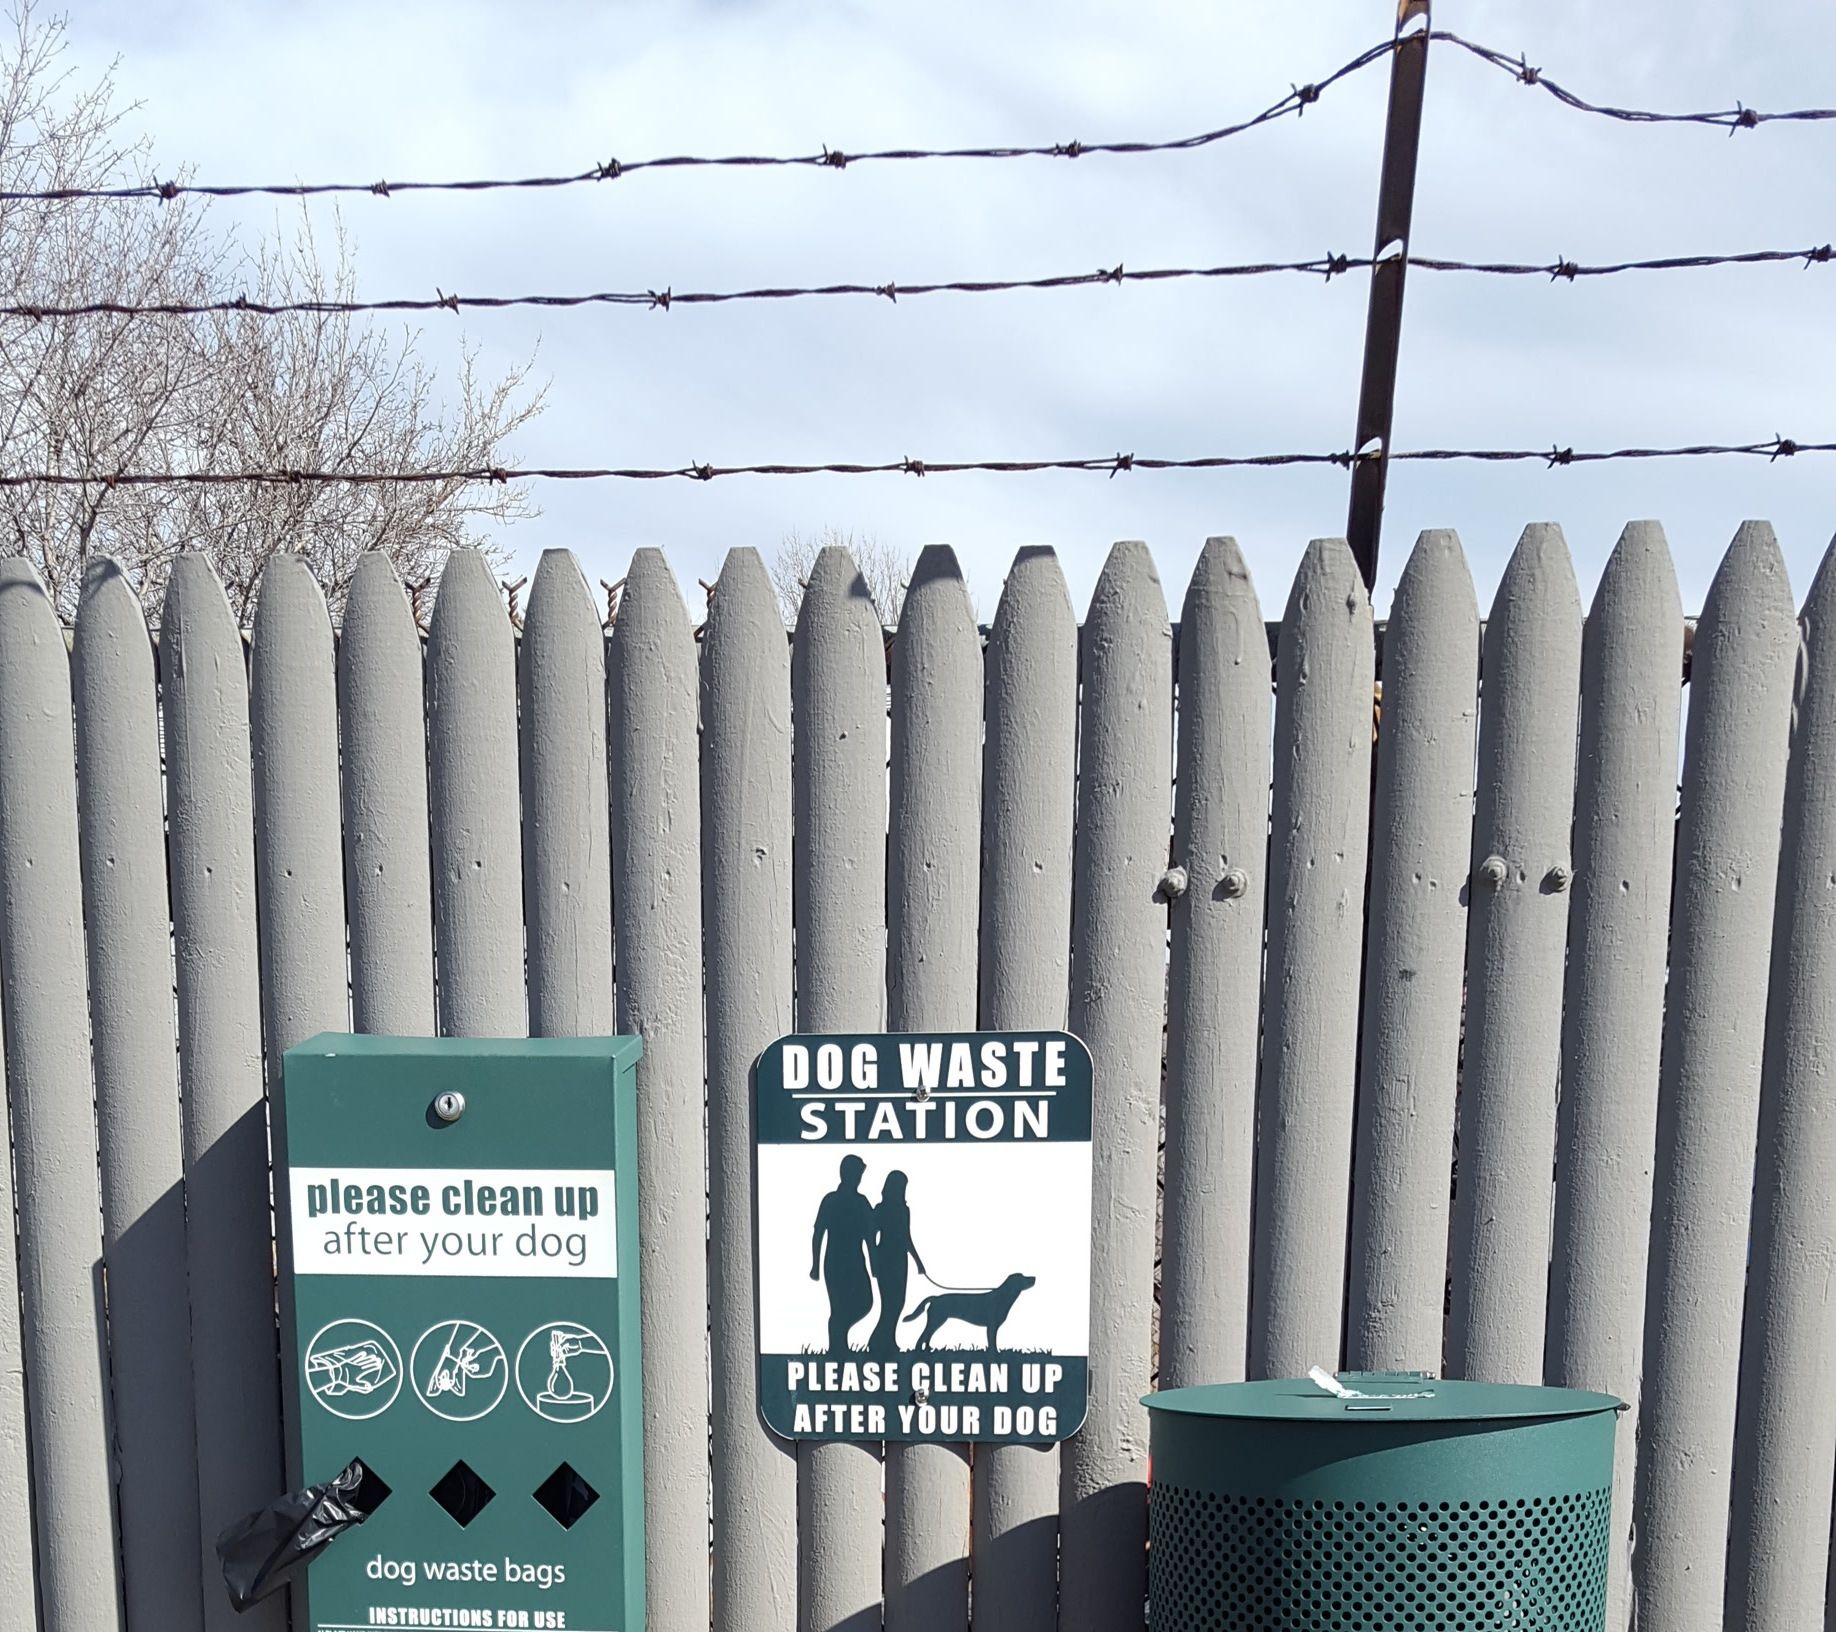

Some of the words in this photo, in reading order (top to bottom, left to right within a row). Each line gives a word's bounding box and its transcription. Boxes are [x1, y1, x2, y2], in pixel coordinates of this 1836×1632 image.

[782, 1043, 879, 1089] DOG
[899, 1041, 1066, 1088] WASTE
[800, 1100, 1049, 1141] STATION
[307, 1178, 431, 1218] please
[442, 1179, 544, 1217] clean
[554, 1186, 599, 1221] up
[323, 1221, 408, 1255] after
[420, 1231, 503, 1265] your
[515, 1223, 587, 1266] dog
[787, 1361, 899, 1392] PLEASE
[911, 1362, 1009, 1393] CLEAN
[1021, 1363, 1063, 1393] UP
[793, 1404, 886, 1435] AFTER
[900, 1405, 980, 1435] YOUR
[993, 1406, 1057, 1436] DOG
[366, 1554, 416, 1586] dog
[423, 1560, 498, 1581] waste
[504, 1557, 566, 1589] bags
[369, 1606, 493, 1627] INSTRUCTIONS
[497, 1609, 529, 1628] FOR
[534, 1611, 566, 1629] USE
